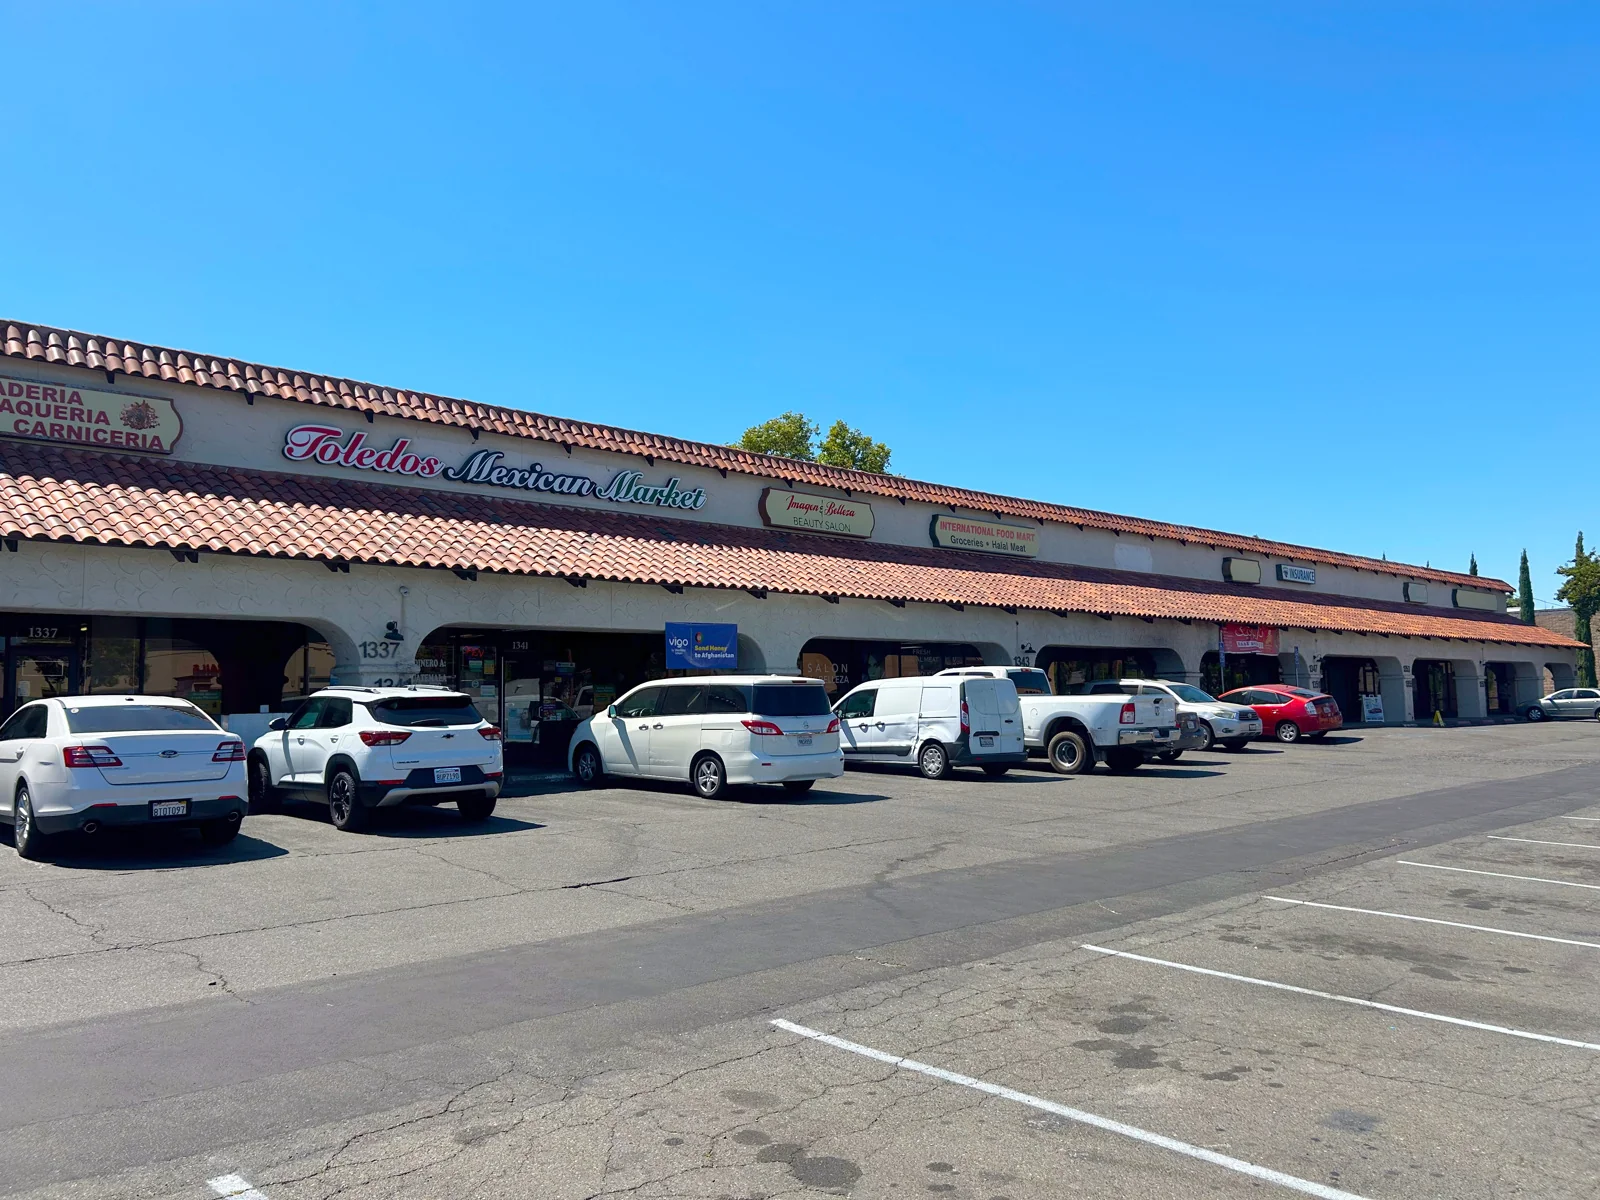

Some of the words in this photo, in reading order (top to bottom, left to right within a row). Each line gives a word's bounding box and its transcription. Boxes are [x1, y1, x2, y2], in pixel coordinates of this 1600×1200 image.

[14, 419, 164, 450] CARNICERIA
[284, 424, 444, 477] Toledos
[447, 449, 597, 497] Mexican
[597, 470, 707, 510] Market
[786, 495, 819, 515] Imagen
[824, 501, 856, 517] Belleza
[793, 516, 823, 528] BEAUTY
[825, 520, 851, 532] SALON
[940, 521, 994, 536] INTERNATIONAL
[996, 529, 1014, 539] FOOD
[1016, 532, 1035, 542] MART
[950, 535, 983, 547] Groceries
[992, 541, 1008, 550] Halal
[1010, 544, 1026, 552] Meat
[1289, 568, 1315, 582] INSURANCE
[28, 627, 58, 639] 1337
[358, 641, 400, 659] 1337
[512, 641, 529, 650] 1341
[669, 636, 688, 648] vigo
[807, 663, 848, 672] SALON
[1013, 656, 1030, 667] 1343
